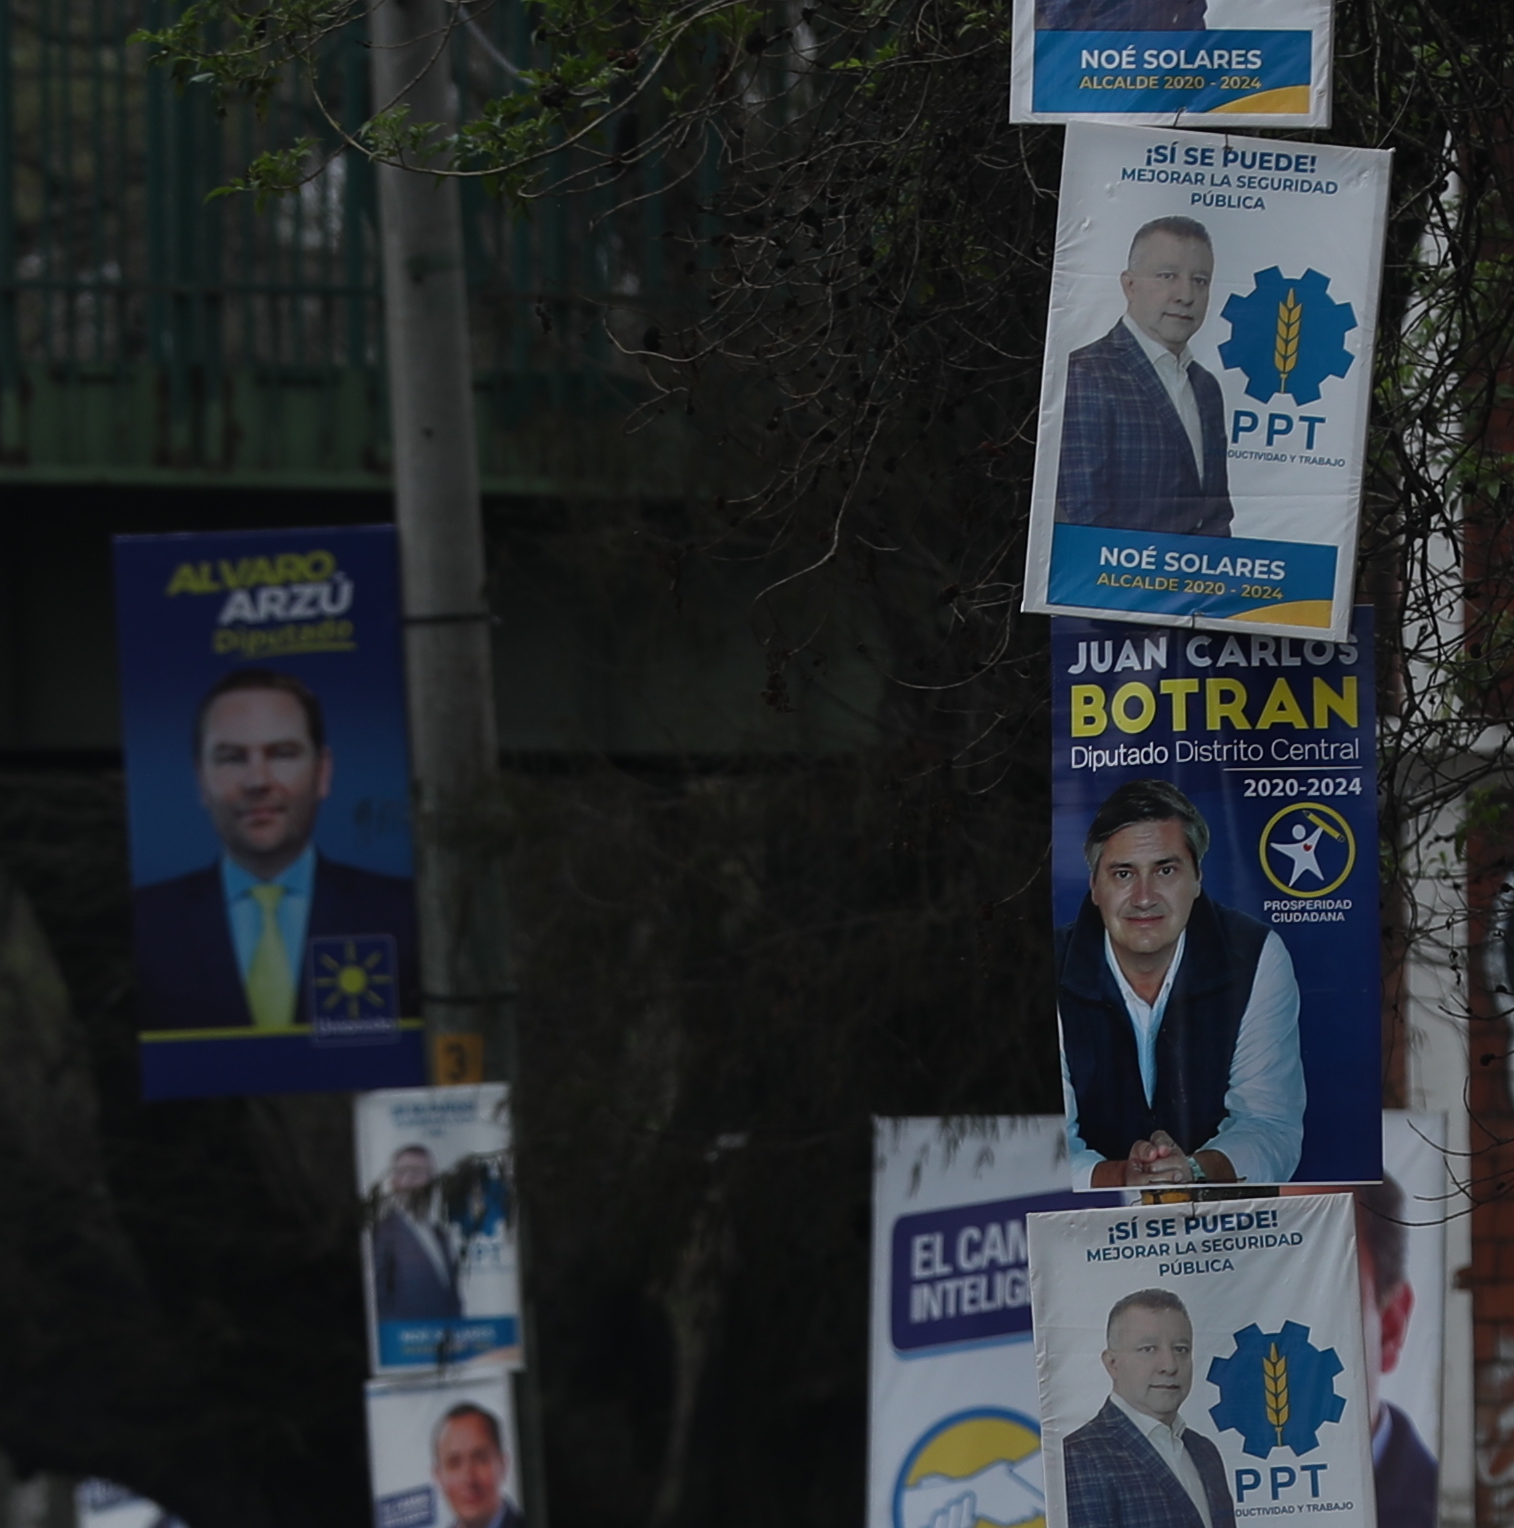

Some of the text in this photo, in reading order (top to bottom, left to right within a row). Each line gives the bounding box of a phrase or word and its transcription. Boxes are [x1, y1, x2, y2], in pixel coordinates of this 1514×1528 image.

[1080, 45, 1262, 70] NOÉ SOLARES
[1079, 75, 1159, 90] ALCALDE
[1164, 75, 1205, 90] 2020
[1220, 75, 1262, 90] 2024
[1145, 141, 1317, 174] ¡SÍ SE PUEDE!
[1121, 167, 1338, 195] MEJORAR LA SEGURIDAD
[1190, 191, 1266, 211] PÚBLICA
[1231, 410, 1327, 450] PPT
[1290, 455, 1296, 463] Y
[1299, 455, 1346, 468] TRABAJO
[165, 548, 337, 598] ALVARO
[1099, 545, 1286, 580] NOÉ SOLARES
[217, 570, 356, 627] ARZÚ
[1096, 572, 1179, 592] ALCALDE
[1183, 580, 1225, 595] 2020
[1240, 584, 1284, 600] 2024
[1067, 634, 1359, 675] JUAN CARLOS
[1070, 675, 1359, 738] BOTRAN
[1070, 738, 1360, 772] Diputado Distrito Central
[1243, 777, 1363, 798] 2020-2024
[1263, 899, 1353, 912] PROSPERIDAD
[1271, 911, 1346, 923] CIUDADANA
[1107, 1209, 1278, 1245] ¡SÍ SE PUEDE!
[911, 1231, 954, 1281] EL
[1086, 1231, 1304, 1262] MEJORAR LA SEGURIDAD
[1159, 1257, 1235, 1277] PÚBLICA
[910, 1267, 1032, 1324] INTELIG
[1235, 1463, 1328, 1503] PPT
[1297, 1504, 1305, 1513] Y
[1306, 1501, 1354, 1513] TRABAJO
